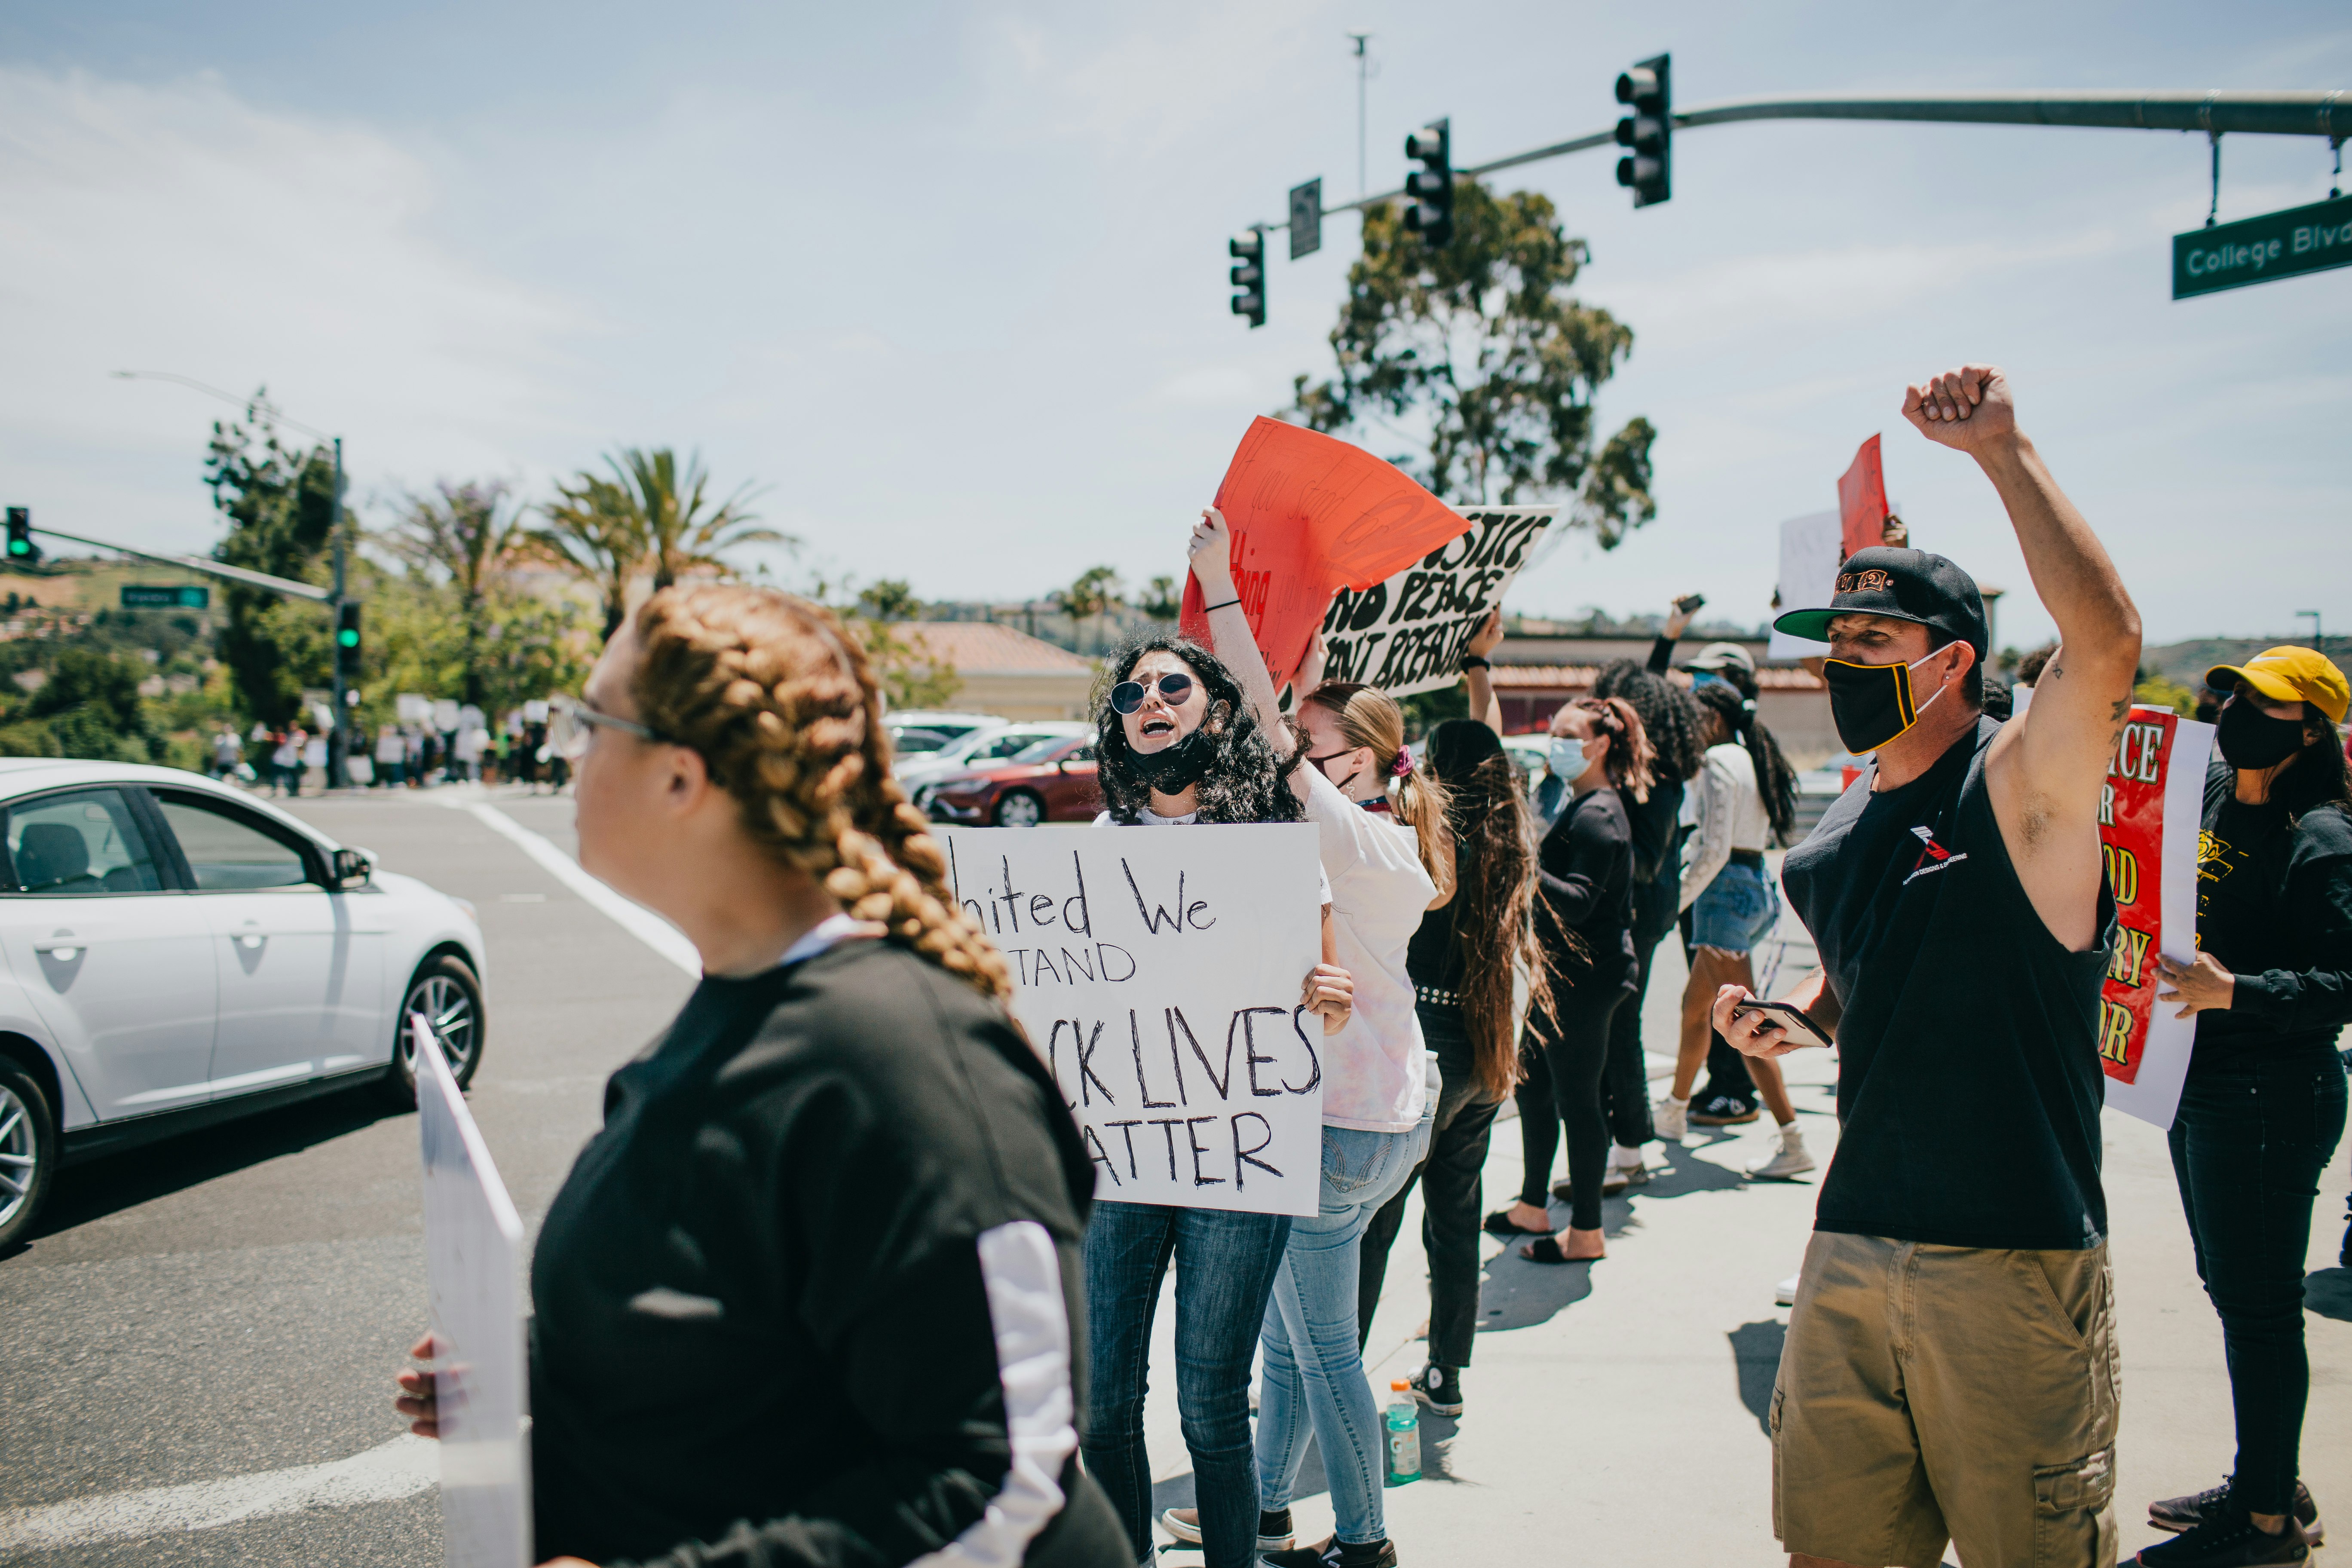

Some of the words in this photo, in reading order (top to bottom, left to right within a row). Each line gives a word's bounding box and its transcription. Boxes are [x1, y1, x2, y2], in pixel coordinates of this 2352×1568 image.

[2188, 238, 2281, 275] College
[1322, 580, 1387, 634] NO
[1321, 631, 1387, 682] AN'T
[1121, 858, 1216, 935] We
[994, 942, 1136, 986] TAND
[1129, 1004, 1321, 1108] LIVES
[1082, 1112, 1284, 1193] ATTER
